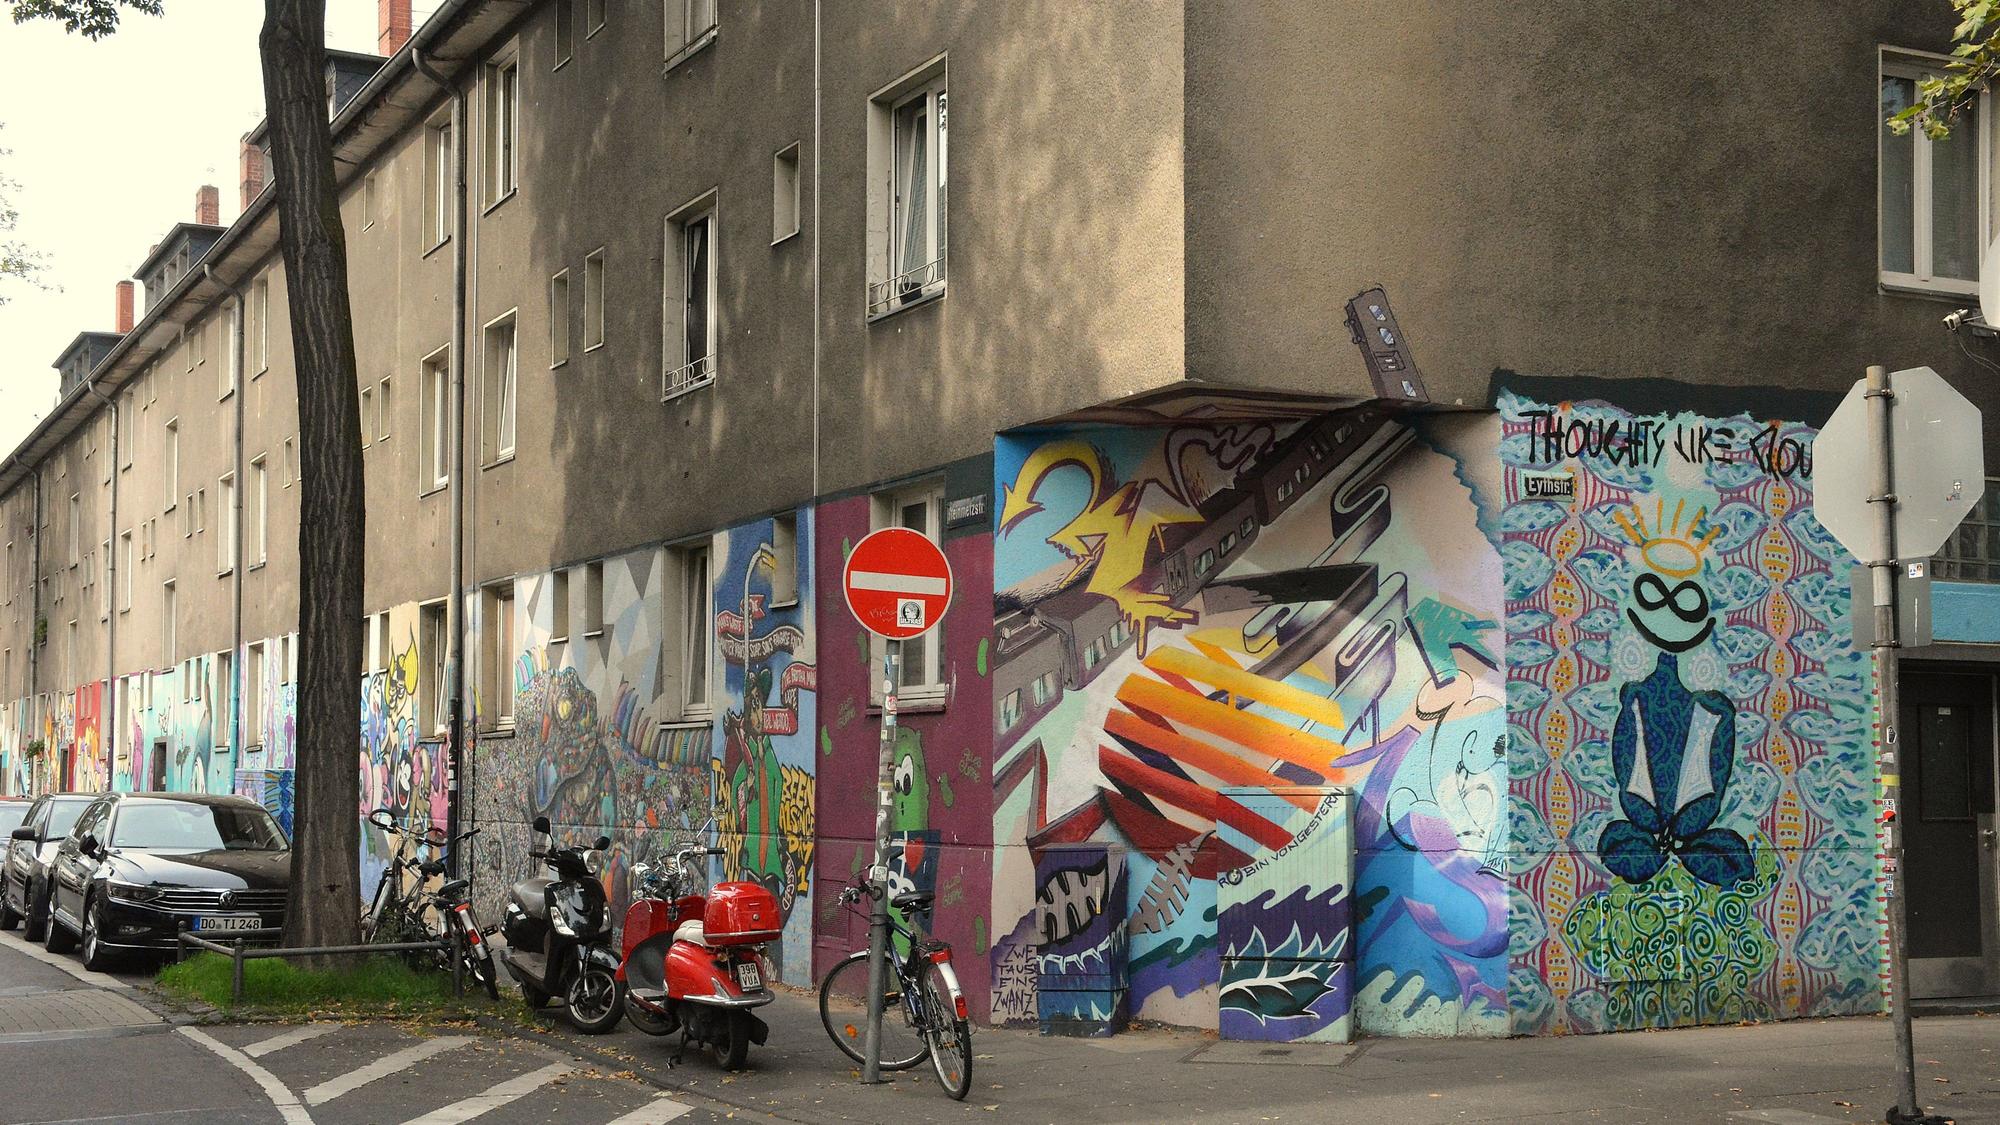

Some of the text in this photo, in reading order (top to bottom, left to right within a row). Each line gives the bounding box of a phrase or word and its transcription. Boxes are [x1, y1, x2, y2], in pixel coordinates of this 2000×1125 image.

[1517, 409, 1665, 468] THOUGHTS
[1674, 423, 1736, 464] LIKE
[1528, 477, 1570, 496] Eythstr.
[201, 918, 260, 930] DO TI 248
[742, 975, 758, 986] VUA
